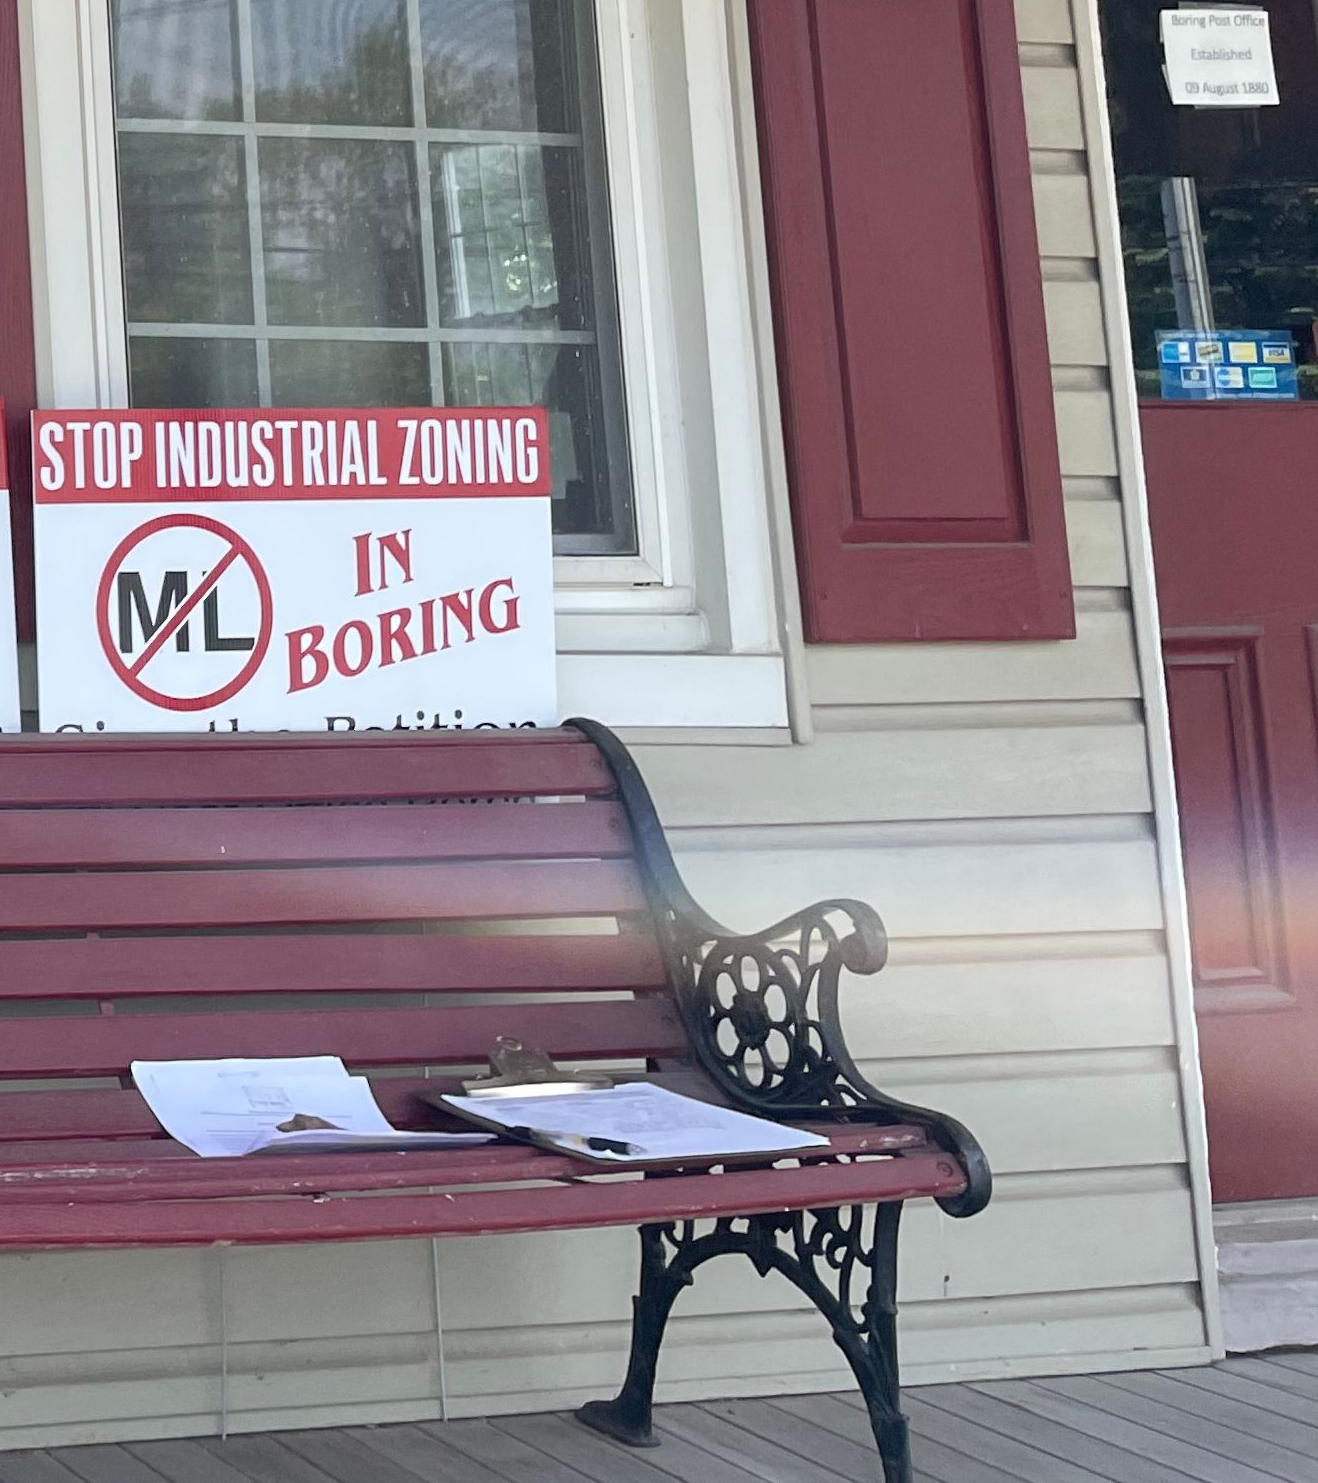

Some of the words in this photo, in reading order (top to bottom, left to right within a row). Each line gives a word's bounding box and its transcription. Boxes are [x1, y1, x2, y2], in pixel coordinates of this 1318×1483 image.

[1171, 14, 1206, 28] Boring
[1209, 15, 1230, 26] Post
[1233, 15, 1265, 27] Office
[1191, 48, 1252, 60] Established
[1185, 82, 1200, 94] 09
[1203, 82, 1238, 96] August
[40, 420, 142, 490] STOP
[157, 419, 387, 489] INDUSTRIAL
[398, 418, 539, 485] ZONING
[352, 529, 414, 597] IN
[117, 570, 255, 653] ML
[284, 578, 520, 694] BORING
